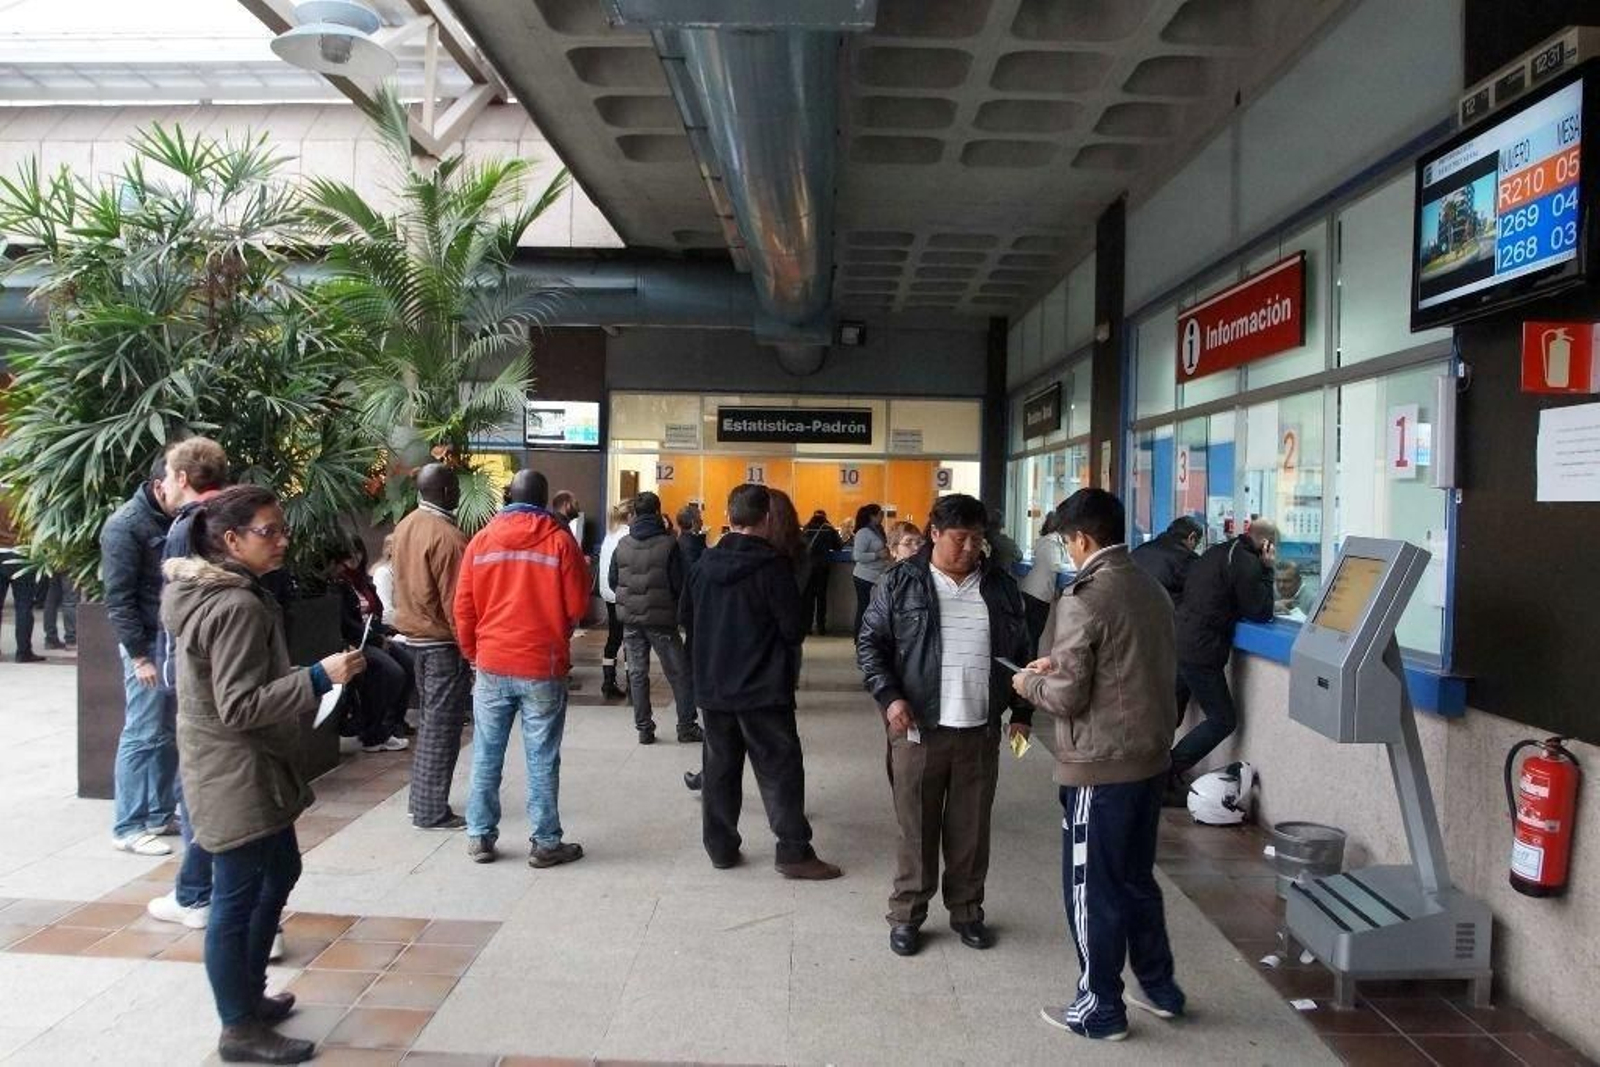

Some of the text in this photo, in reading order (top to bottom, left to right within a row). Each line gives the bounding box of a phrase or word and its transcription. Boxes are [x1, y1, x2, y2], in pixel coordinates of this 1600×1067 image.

[1557, 113, 1580, 145] MESA
[1499, 150, 1580, 208] R210 05
[1498, 187, 1578, 239] I269 04
[1498, 236, 1538, 269] I268
[1551, 221, 1577, 250] 03
[1206, 294, 1291, 350] Información
[1283, 431, 1296, 470] 2
[1395, 416, 1409, 468] 1
[656, 465, 674, 480] 12
[747, 467, 765, 483] 11
[841, 469, 859, 484] 10
[937, 470, 949, 488] 9
[1179, 450, 1187, 483] 3
